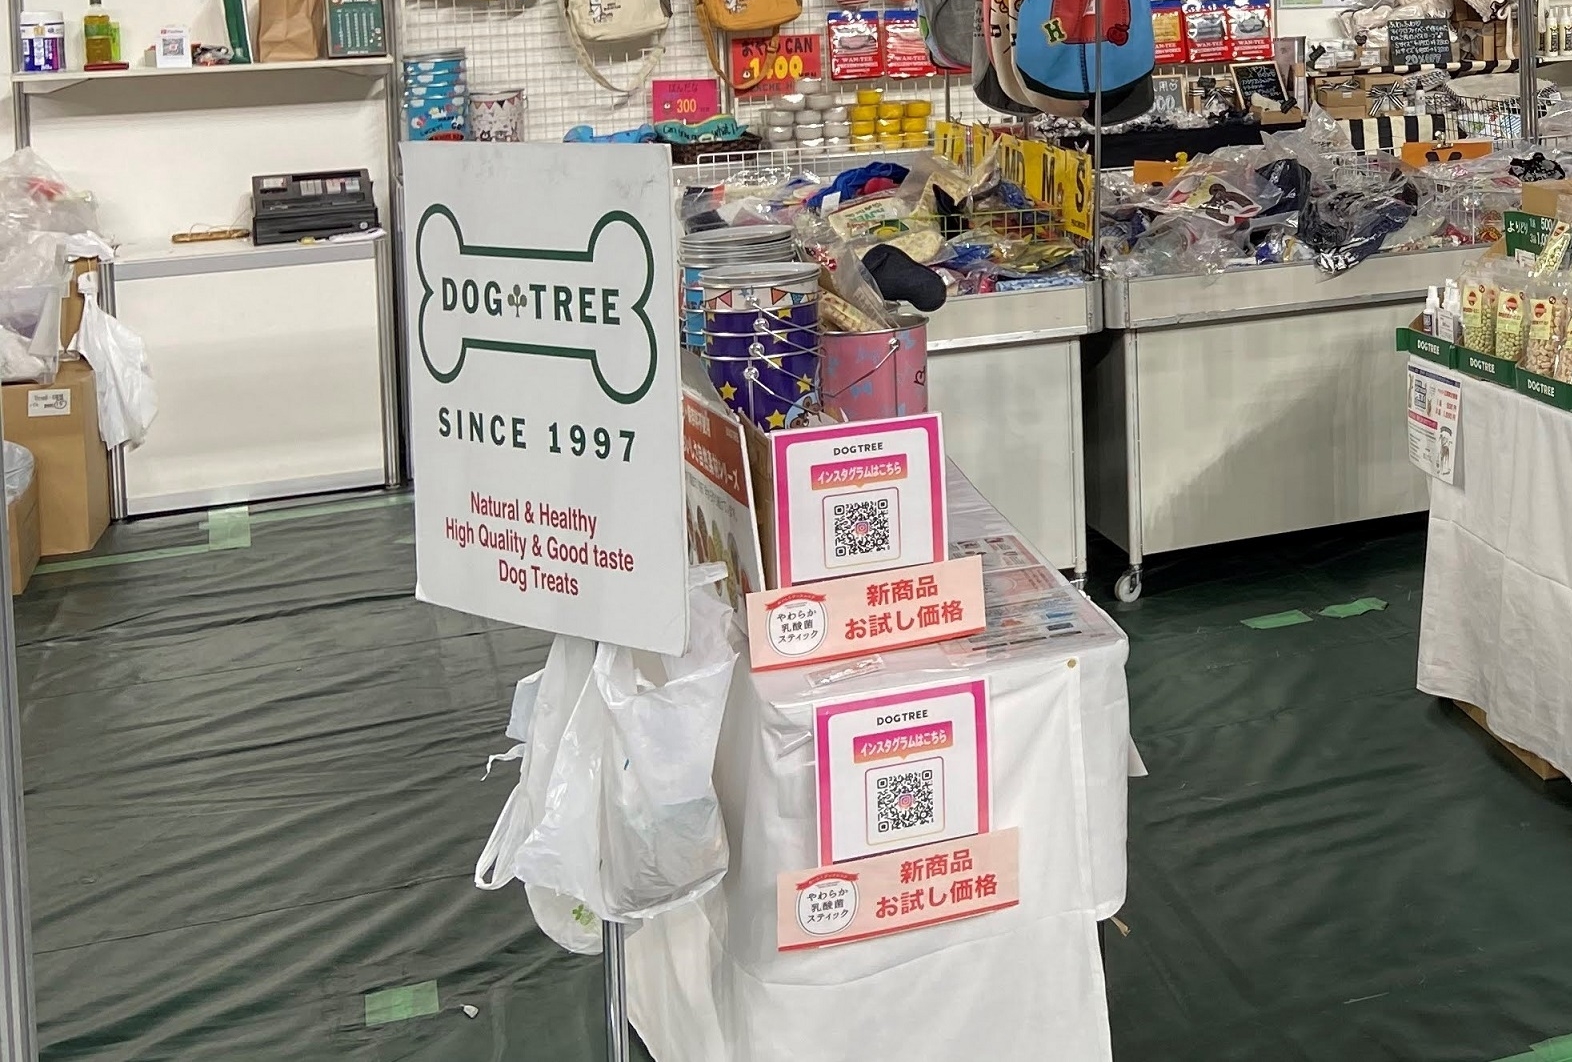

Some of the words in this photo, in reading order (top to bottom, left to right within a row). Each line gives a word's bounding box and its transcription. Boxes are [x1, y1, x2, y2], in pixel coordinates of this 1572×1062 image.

[785, 38, 812, 54] CAN
[677, 99, 696, 113] 300
[442, 277, 502, 316] DOG
[529, 284, 620, 326] TREE
[438, 407, 526, 450] SINCE
[548, 422, 636, 462] 1997
[833, 441, 883, 456] DOGTREE
[817, 461, 902, 485] インスタグラムはこちら
[470, 491, 519, 522] Natural
[524, 505, 534, 524] &
[539, 502, 597, 539] Healthy
[445, 517, 475, 547] High
[478, 523, 526, 559] Quality
[532, 539, 542, 558] &
[546, 536, 589, 565] Good
[593, 545, 634, 572] taste
[498, 558, 527, 592] Dog
[530, 564, 579, 596] Treats
[866, 574, 939, 608] 新商品
[777, 609, 817, 621] やわらか
[781, 620, 814, 632] 乳酸菌
[844, 600, 963, 641] お試し価格
[778, 629, 818, 643] スティック
[876, 709, 928, 726] DOGTREE
[860, 730, 946, 758] インスタグラムはこちら
[899, 849, 973, 884] 新商品
[807, 888, 849, 901] やわらか
[810, 899, 844, 913] 乳酸菌
[875, 875, 997, 918] お試し価格
[806, 908, 849, 924] スティック
